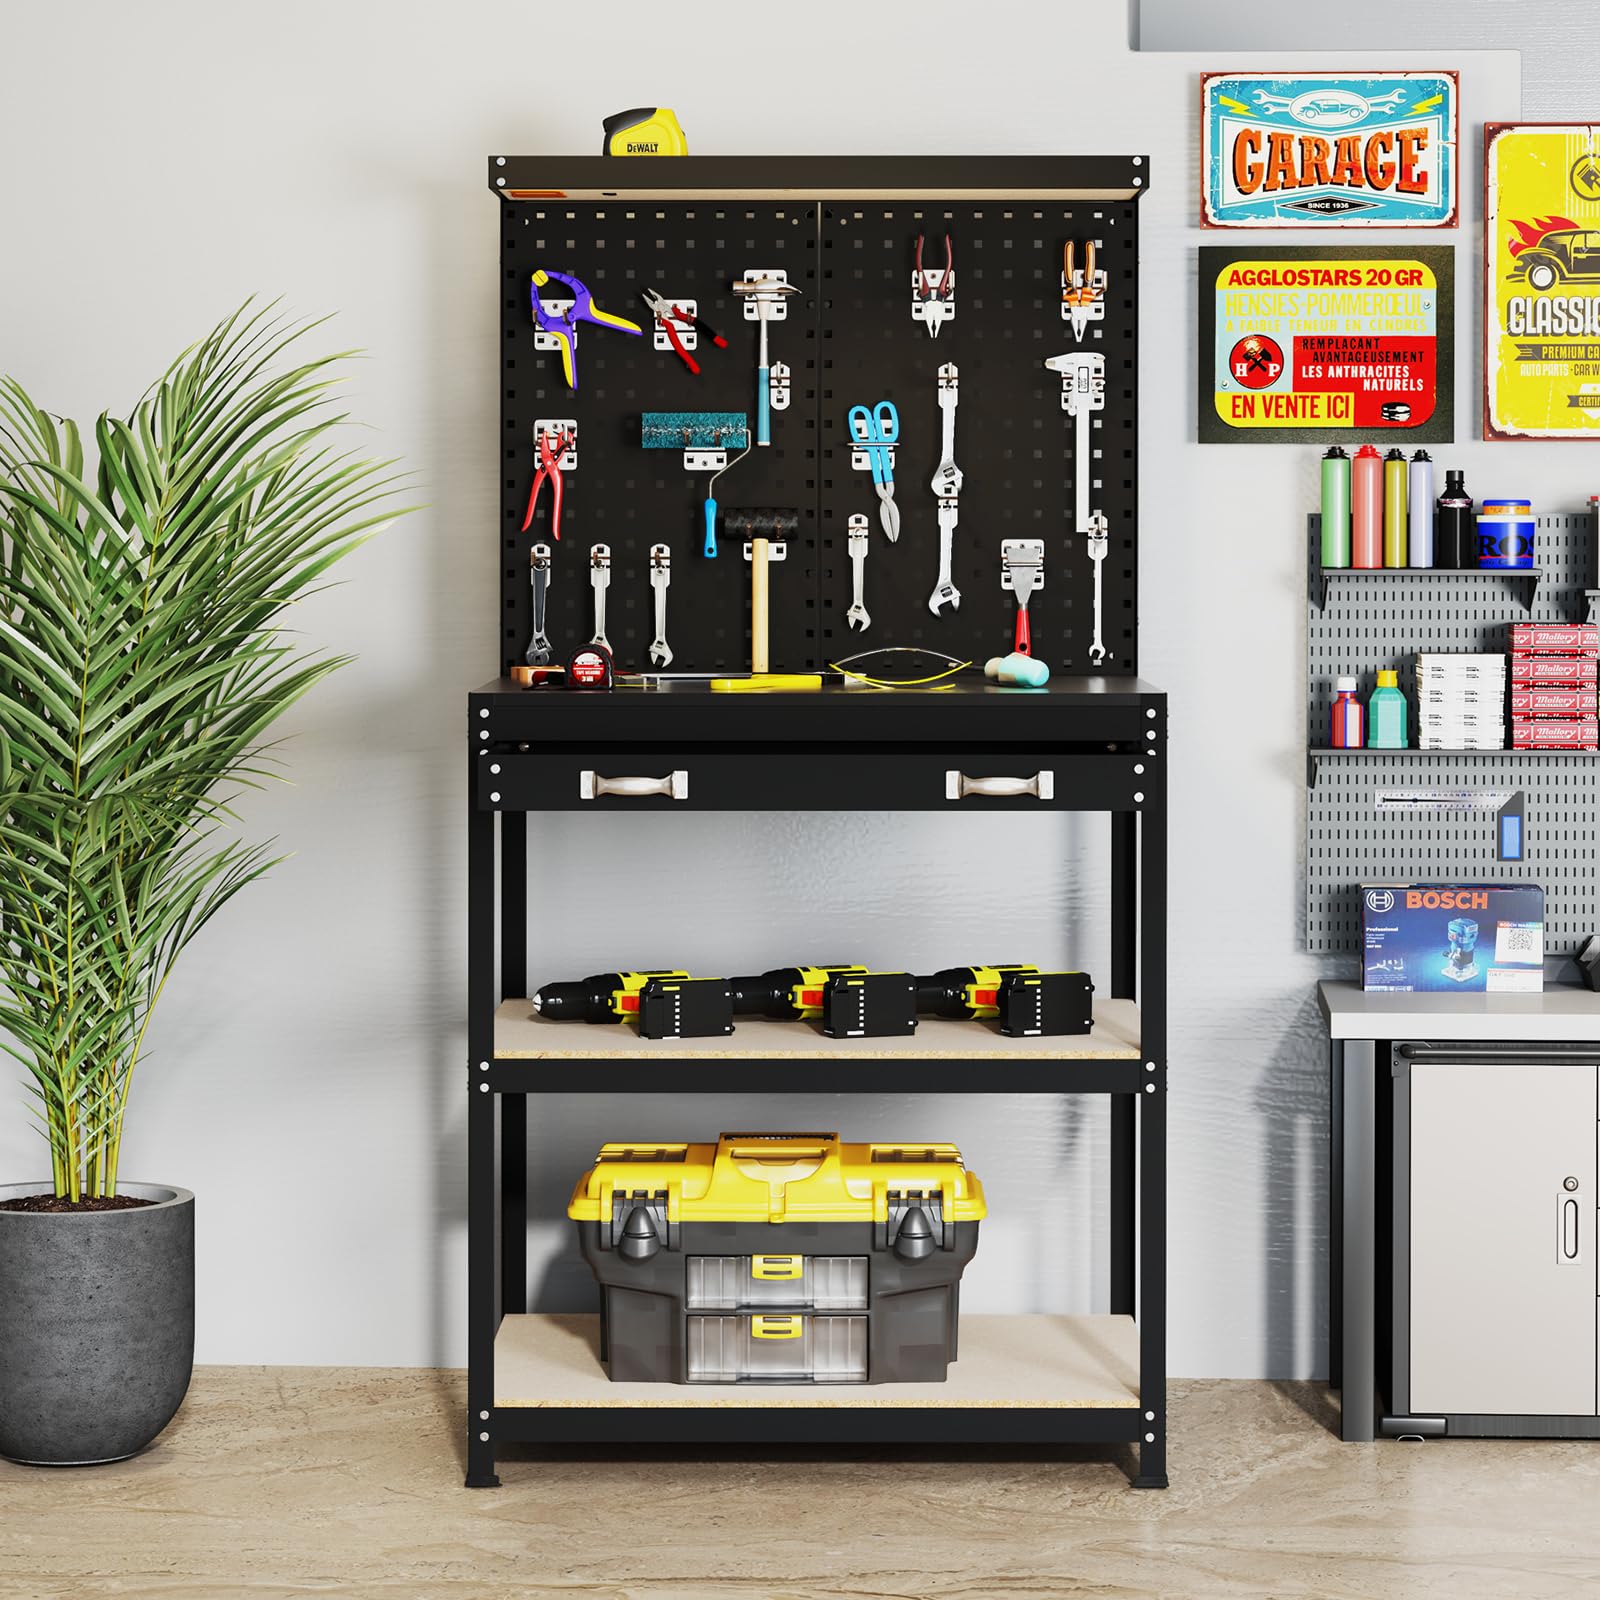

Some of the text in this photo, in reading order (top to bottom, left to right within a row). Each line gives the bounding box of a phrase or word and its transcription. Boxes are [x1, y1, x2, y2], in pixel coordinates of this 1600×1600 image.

[1233, 127, 1428, 195] GARAGE
[1229, 269, 1423, 286] AGGLOSTARS 20 GR
[1225, 293, 1424, 317] HENSIES-POMMERŒUL
[1240, 319, 1280, 333] FAIBLE
[1289, 319, 1337, 332] TENEUR
[1345, 319, 1361, 332] EN
[1369, 318, 1427, 332] CENDRES
[1312, 351, 1424, 363] AVANTAGEUSEMENT
[1541, 346, 1585, 359] PREMIUM
[1235, 363, 1248, 376] H
[1268, 363, 1280, 376] P
[1302, 365, 1410, 378] LES ANTHRACITES
[1520, 363, 1541, 376] AUTO
[1542, 363, 1569, 376] PARTS
[1573, 363, 1590, 376] CAR
[1363, 378, 1424, 391] NATURELS
[1231, 395, 1349, 418] EN VENTE ICI
[1537, 632, 1576, 643] Mallory
[1536, 664, 1576, 675] Mallory
[1536, 696, 1576, 707] Mallory
[1537, 727, 1576, 738] Mallory
[1406, 892, 1488, 909] BOSCH
